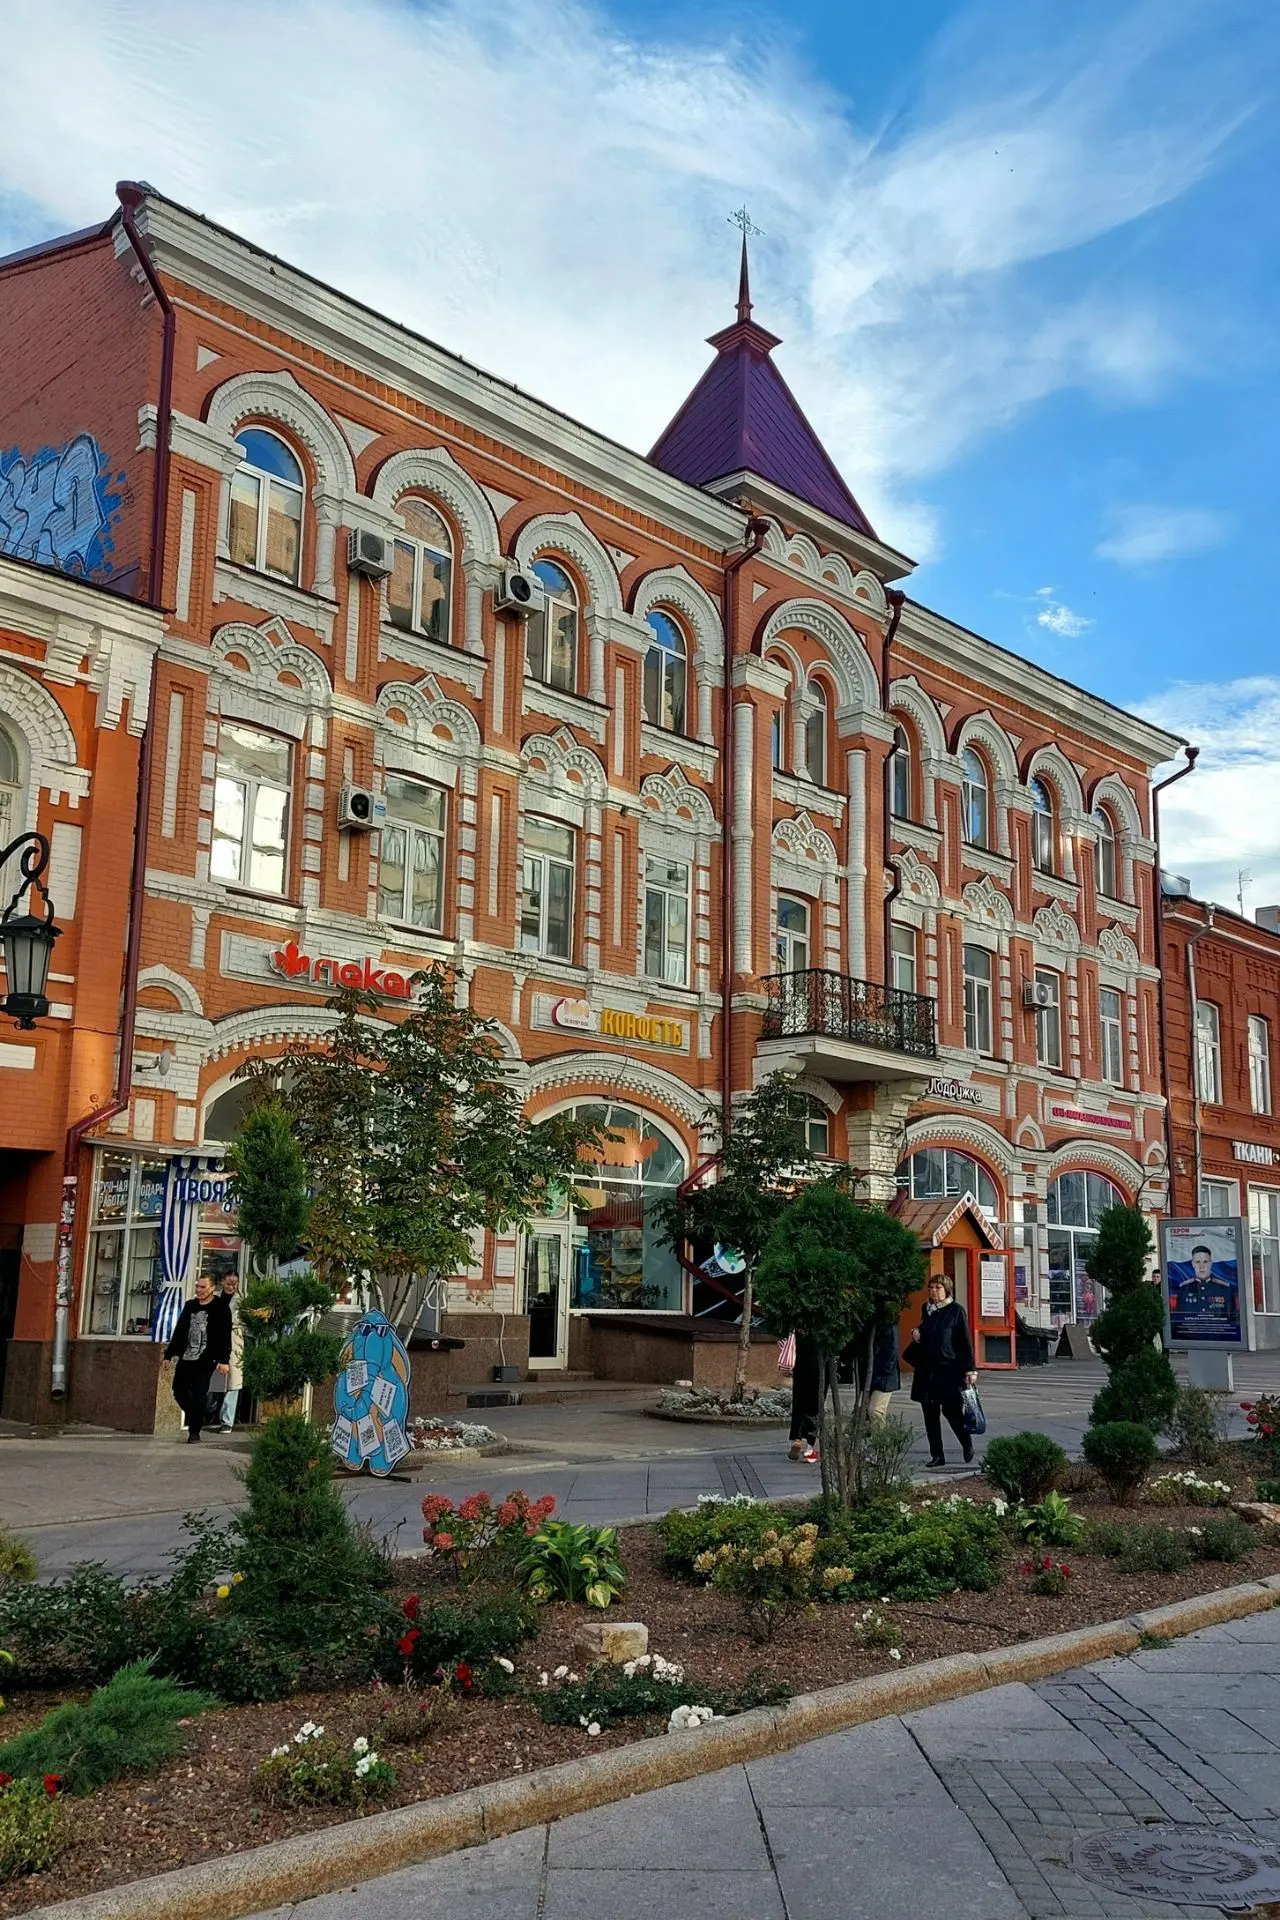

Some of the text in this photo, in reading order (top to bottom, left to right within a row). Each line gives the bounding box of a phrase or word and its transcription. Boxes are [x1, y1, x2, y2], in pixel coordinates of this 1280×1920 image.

[311, 957, 421, 999] rieker
[1232, 1141, 1273, 1167] ТКАНИ
[136, 1183, 165, 1199] ПОДАРК
[174, 1177, 223, 1203] ТВОЯ
